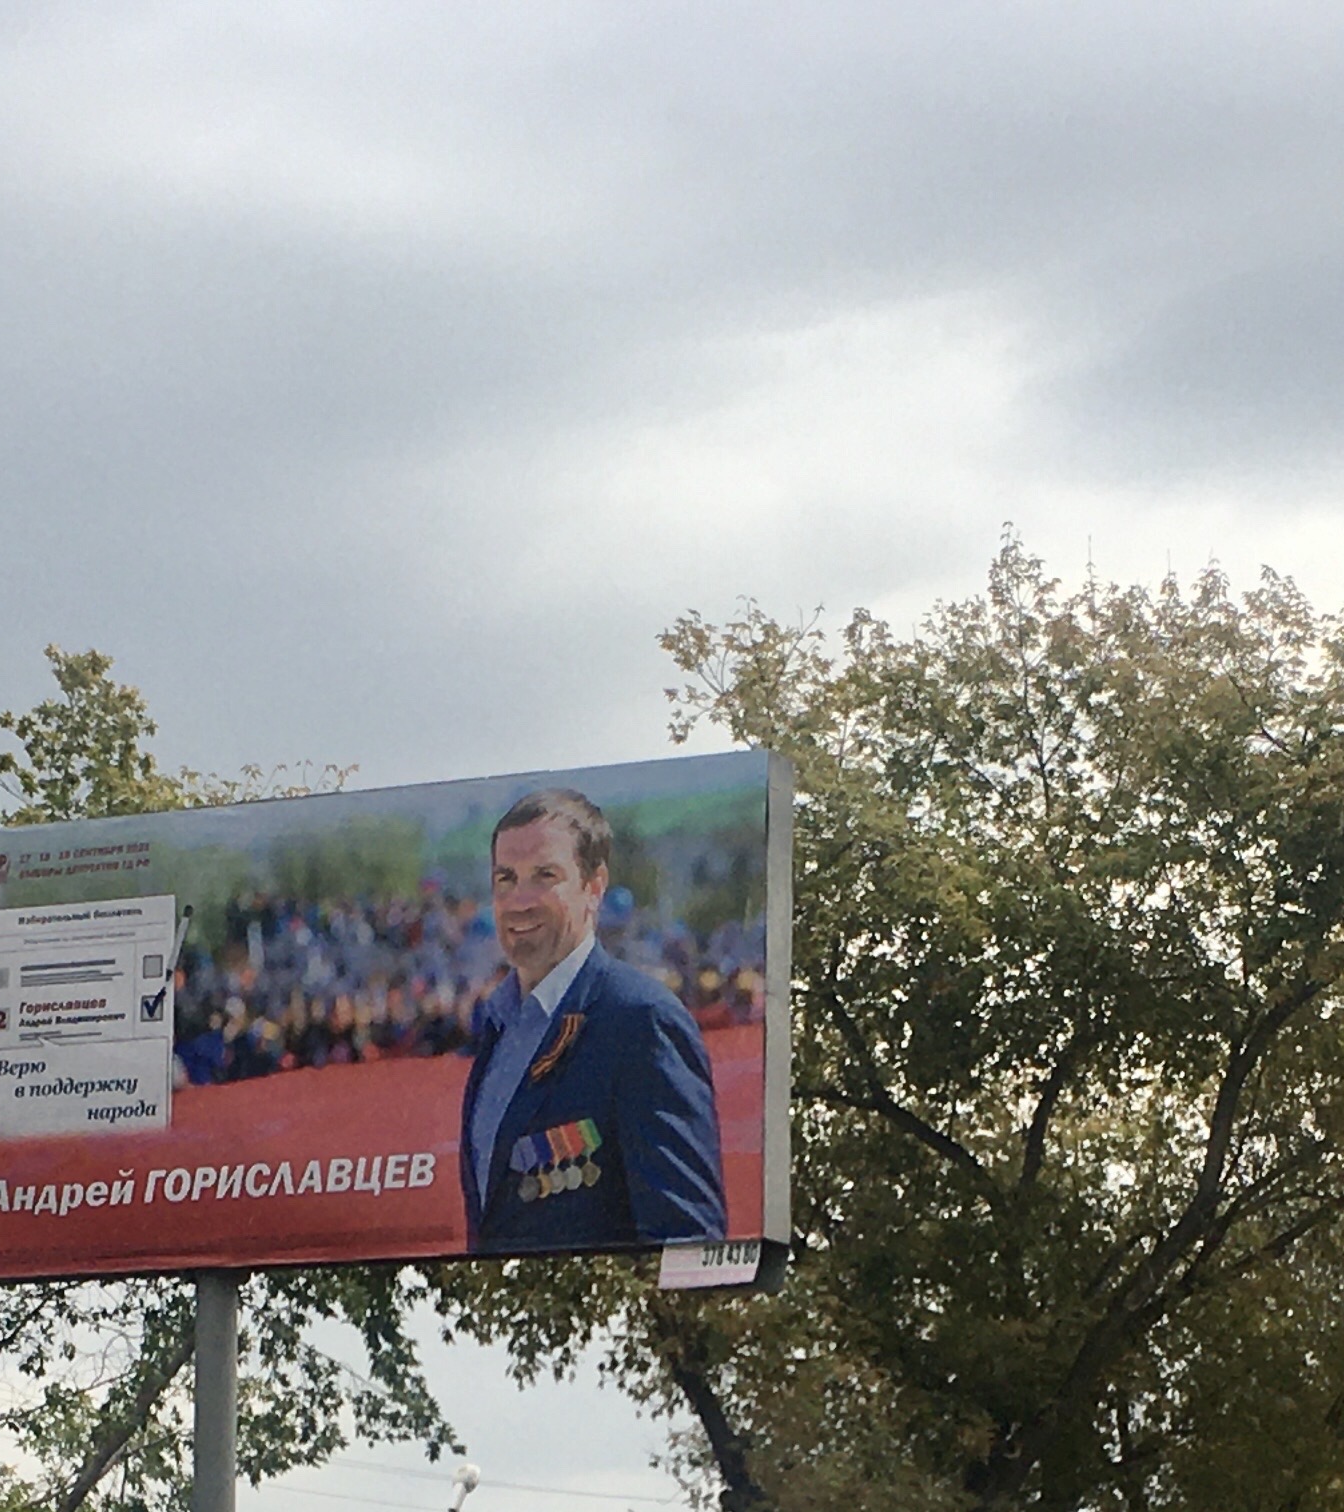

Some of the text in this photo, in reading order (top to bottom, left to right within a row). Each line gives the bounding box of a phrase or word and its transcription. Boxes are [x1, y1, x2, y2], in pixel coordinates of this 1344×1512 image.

[14, 1077, 139, 1099] в поддержку
[87, 1100, 158, 1124] народа
[144, 1152, 437, 1203] ГОРИСЛАВЦЕВ
